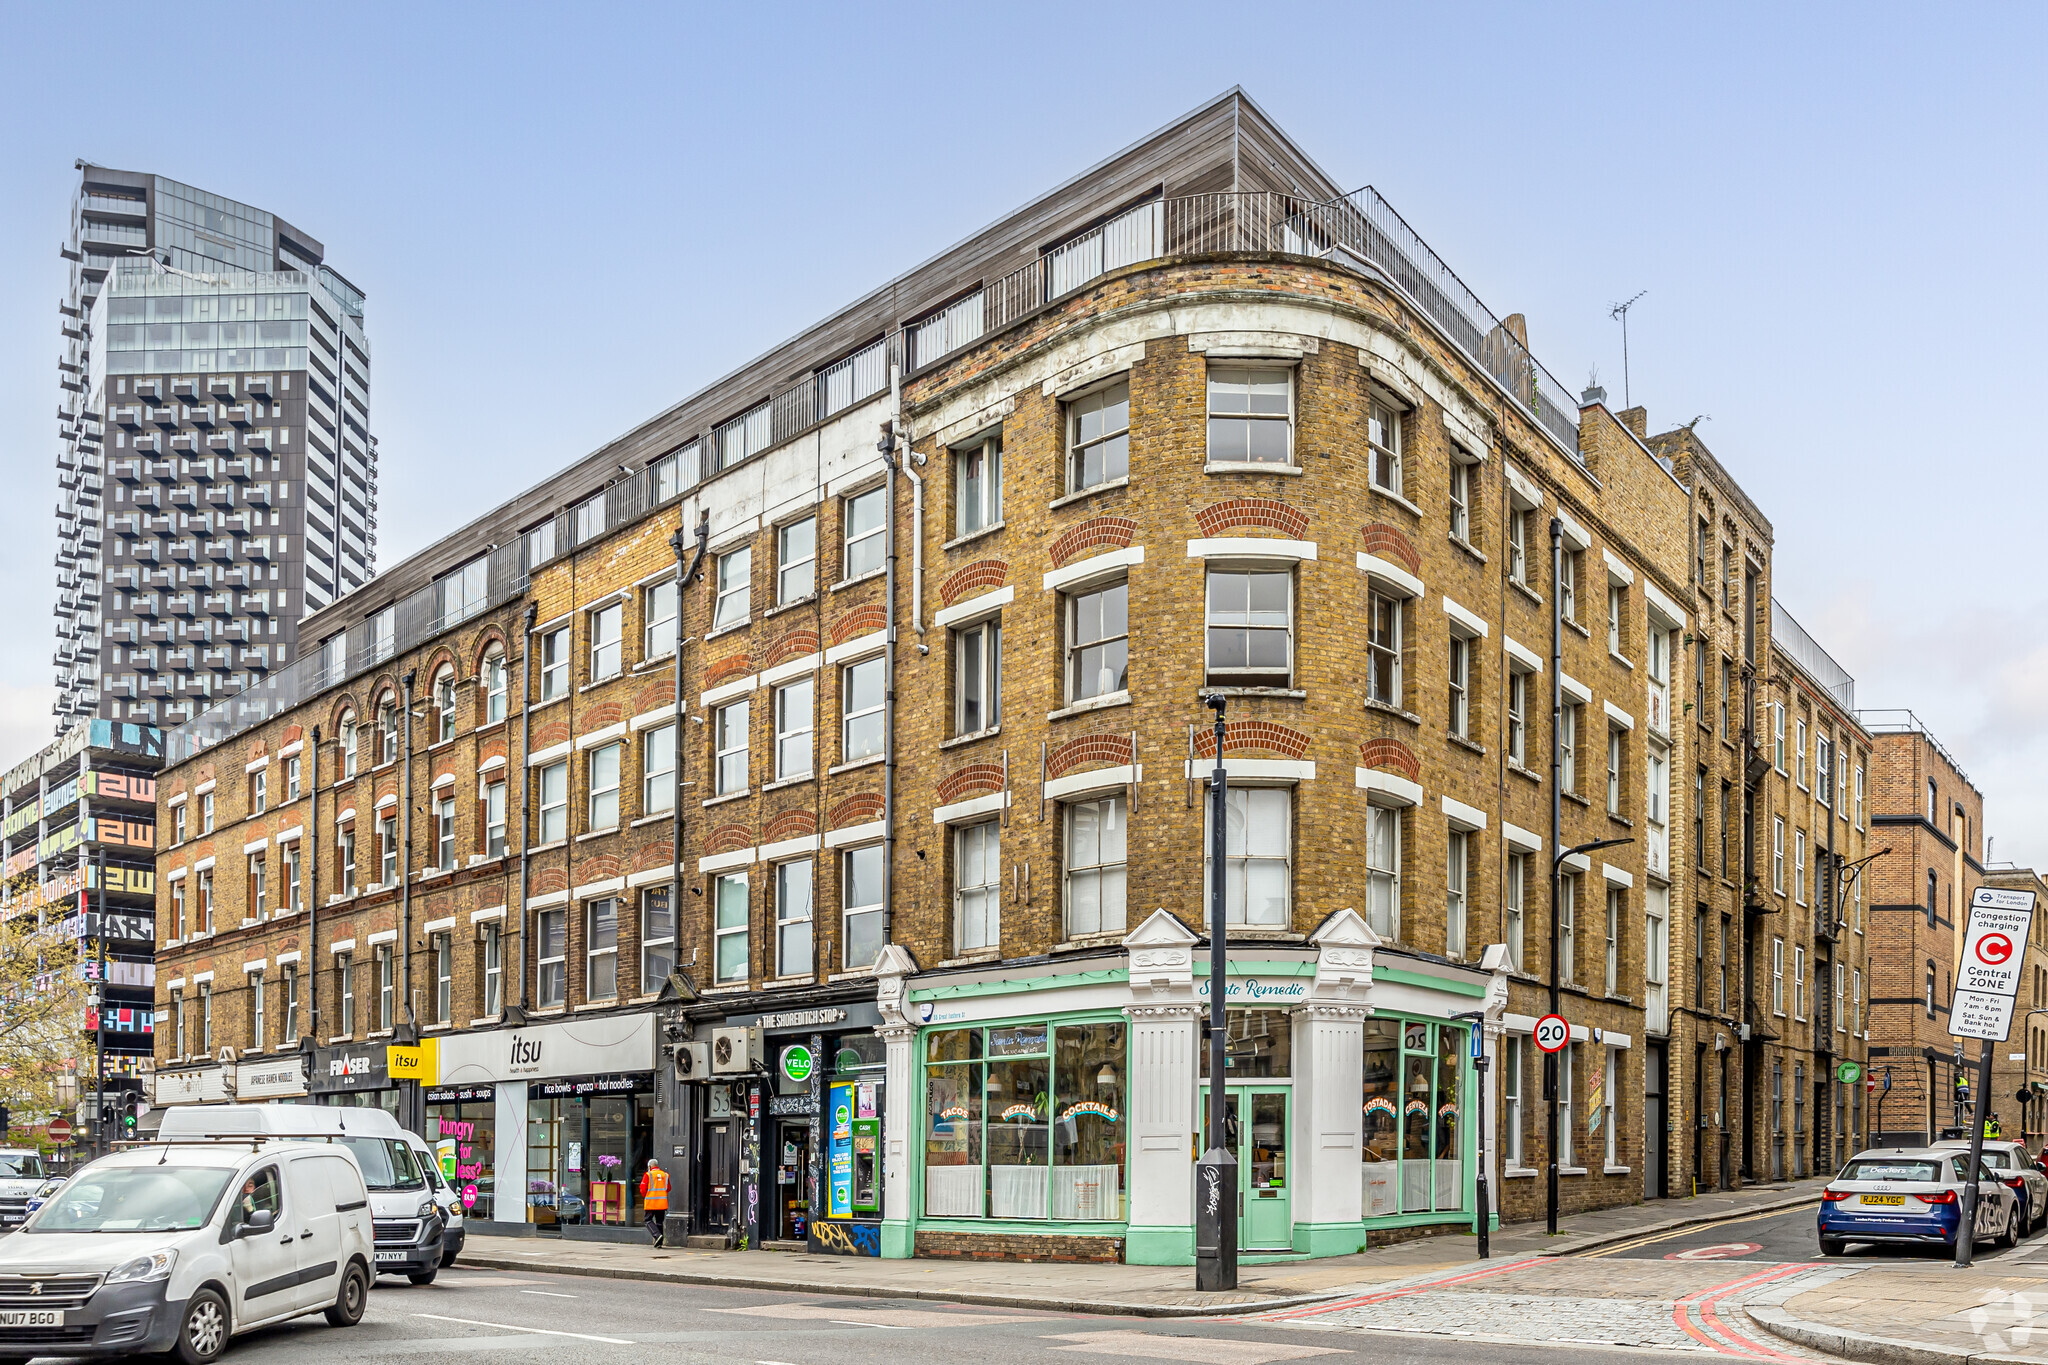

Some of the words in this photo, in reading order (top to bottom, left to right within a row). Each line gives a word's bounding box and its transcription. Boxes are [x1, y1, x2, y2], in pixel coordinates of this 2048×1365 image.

[1997, 893, 2026, 901] Transport
[1973, 911, 2027, 922] Congestion
[1978, 921, 2019, 931] charging
[1967, 966, 2012, 979] Central
[1199, 978, 1241, 996] Sto
[1245, 978, 1305, 998] Remedio
[1969, 977, 2005, 990] ZONE
[762, 1014, 777, 1028] THE
[776, 1010, 818, 1028] SHOREDITCH
[819, 1008, 837, 1023] STOP
[1964, 1019, 1982, 1027] Bank
[1539, 1024, 1564, 1042] 20
[1957, 1026, 1977, 1034] Noon
[511, 1034, 542, 1064] itsu
[329, 1052, 370, 1076] FRASER
[394, 1053, 419, 1067] itsu
[459, 1089, 472, 1099] sushi
[544, 1084, 554, 1094] rice
[555, 1082, 571, 1093] bowls
[609, 1078, 634, 1089] noodles
[713, 1090, 730, 1112] 53
[1363, 1096, 1397, 1118] TOSTADAS
[1405, 1099, 1429, 1119] CERVEZA
[940, 1106, 969, 1122] TACOS
[1001, 1104, 1036, 1122] MEZCAL
[1062, 1101, 1118, 1122] COCKTAILS
[1438, 1102, 1460, 1119] TEQUILA
[439, 1114, 475, 1142] hungry
[459, 1142, 472, 1159] for
[456, 1159, 482, 1180] less?
[1863, 1195, 1883, 1203] RJ24
[1885, 1196, 1902, 1204] YGC
[388, 1252, 403, 1260] NYY
[0, 1312, 26, 1324] NU17
